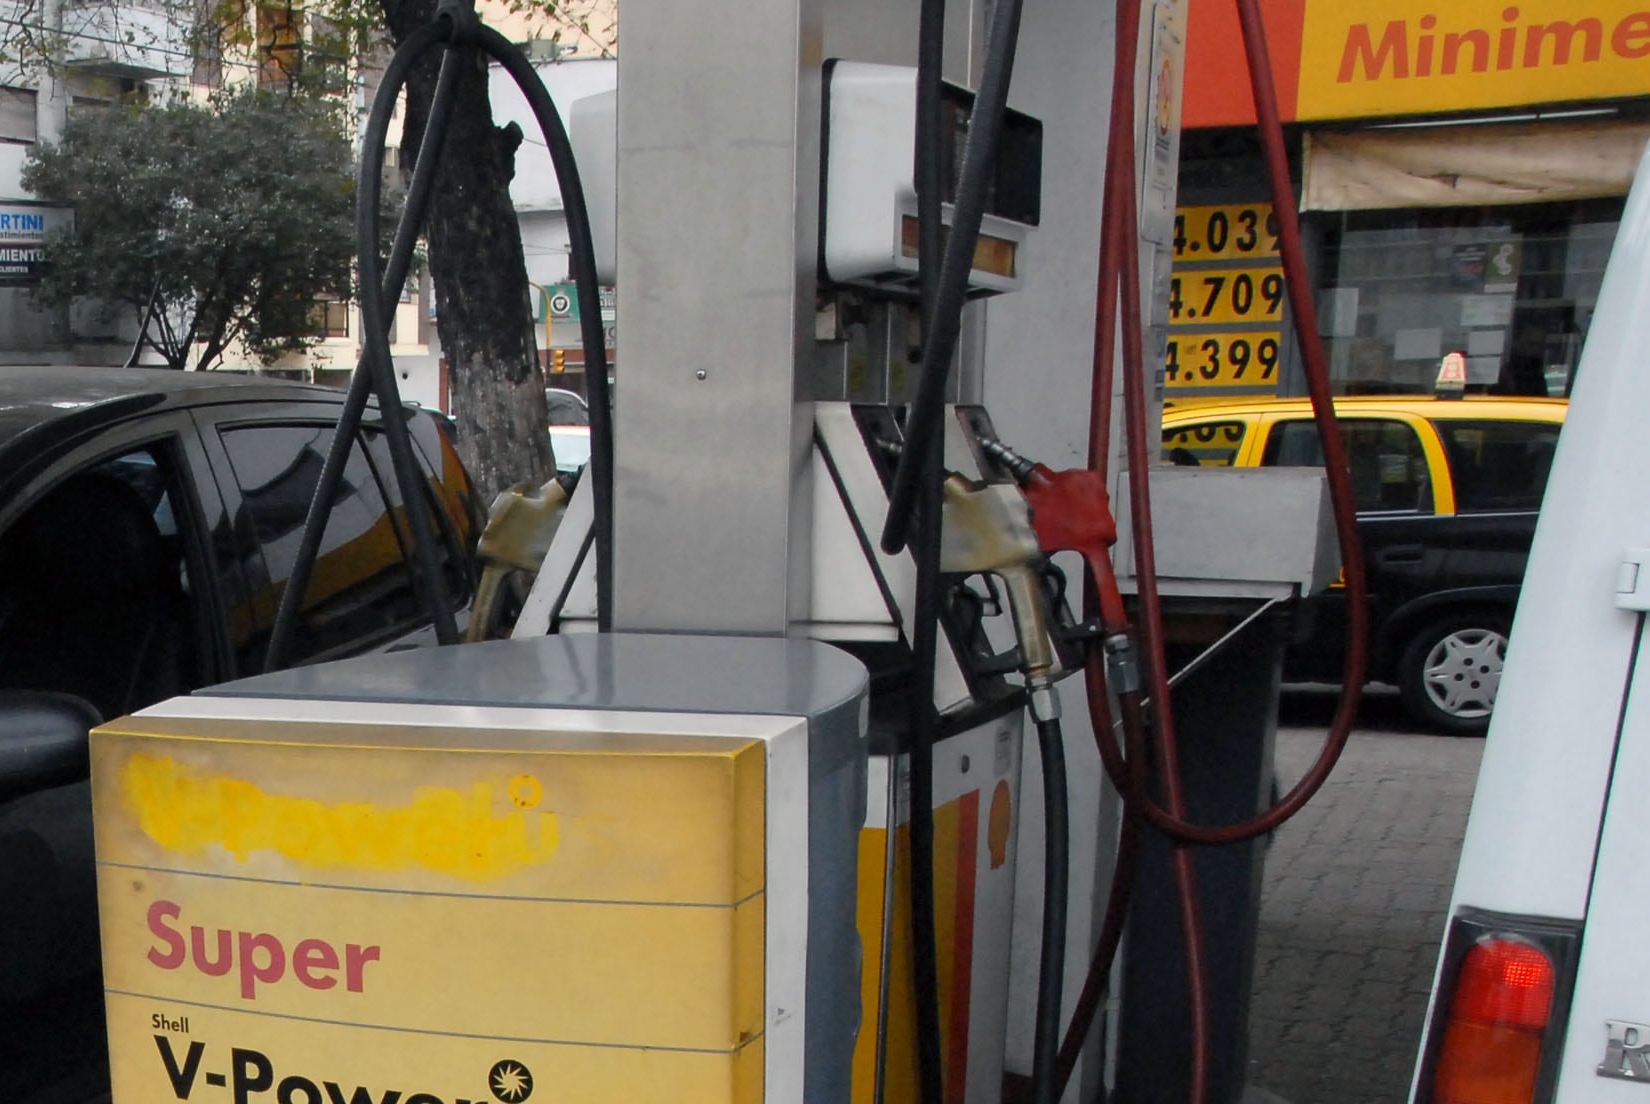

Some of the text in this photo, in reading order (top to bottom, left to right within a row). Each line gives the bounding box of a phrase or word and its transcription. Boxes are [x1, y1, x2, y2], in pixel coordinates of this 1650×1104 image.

[1168, 272, 1285, 319] 4.709
[1165, 337, 1279, 382] 4.399
[146, 900, 381, 1000] Super
[151, 1013, 189, 1034] Shell
